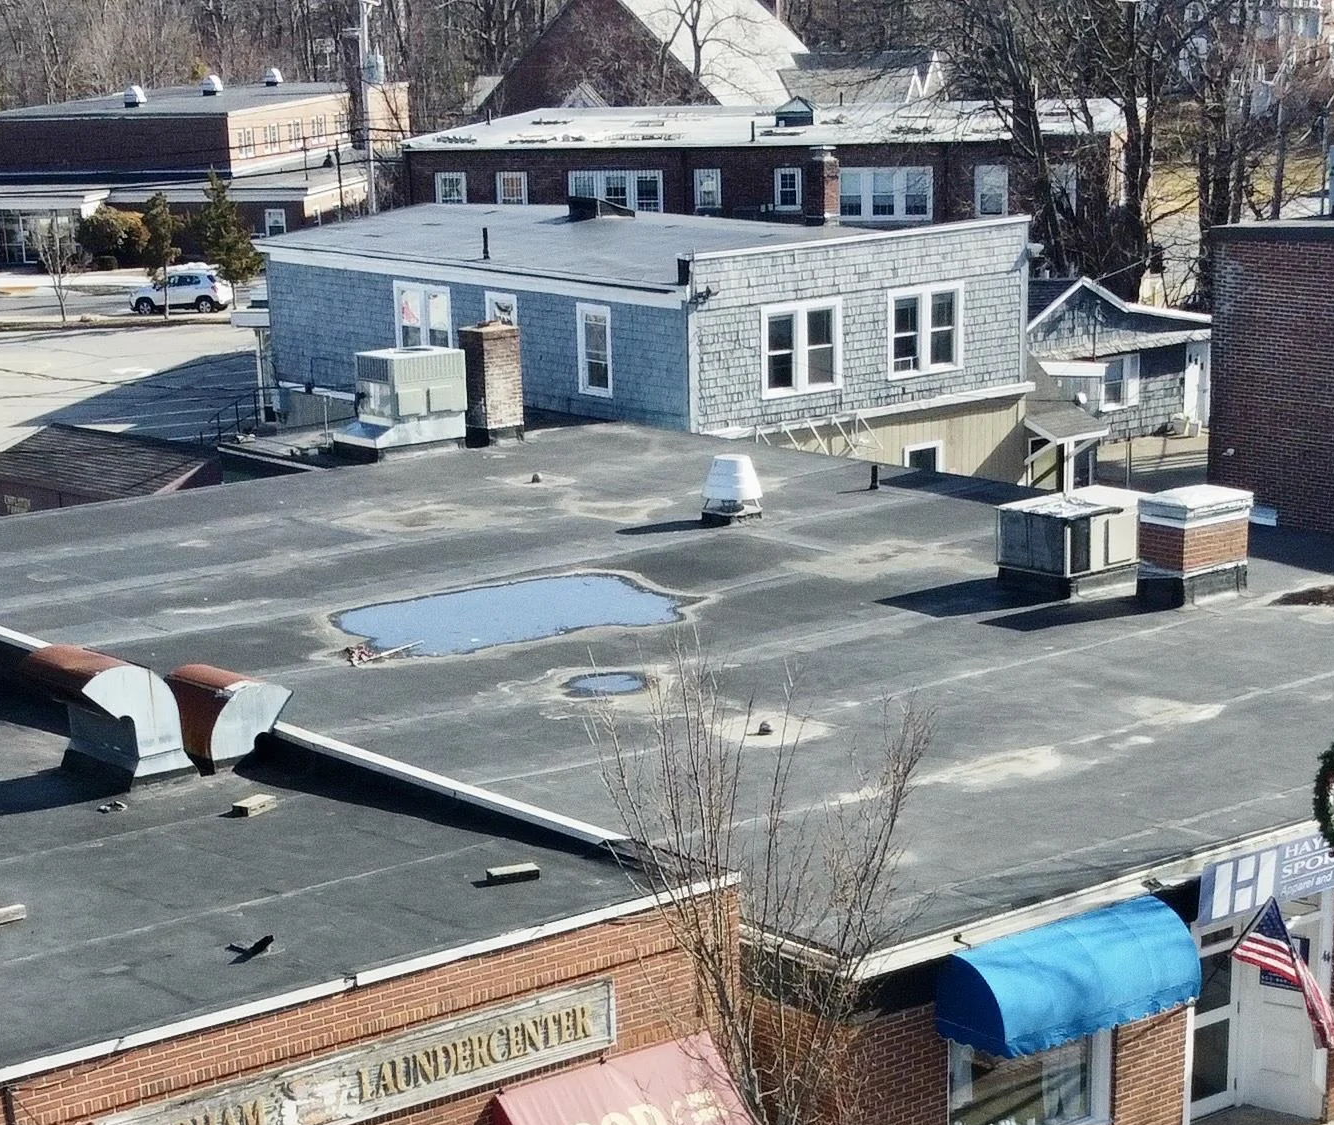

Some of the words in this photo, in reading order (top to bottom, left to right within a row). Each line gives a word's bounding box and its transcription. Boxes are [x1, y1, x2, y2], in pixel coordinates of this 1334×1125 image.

[1280, 877, 1315, 897] Apparel
[1316, 870, 1333, 886] and
[354, 1003, 597, 1106] LAUNDERCENTER
